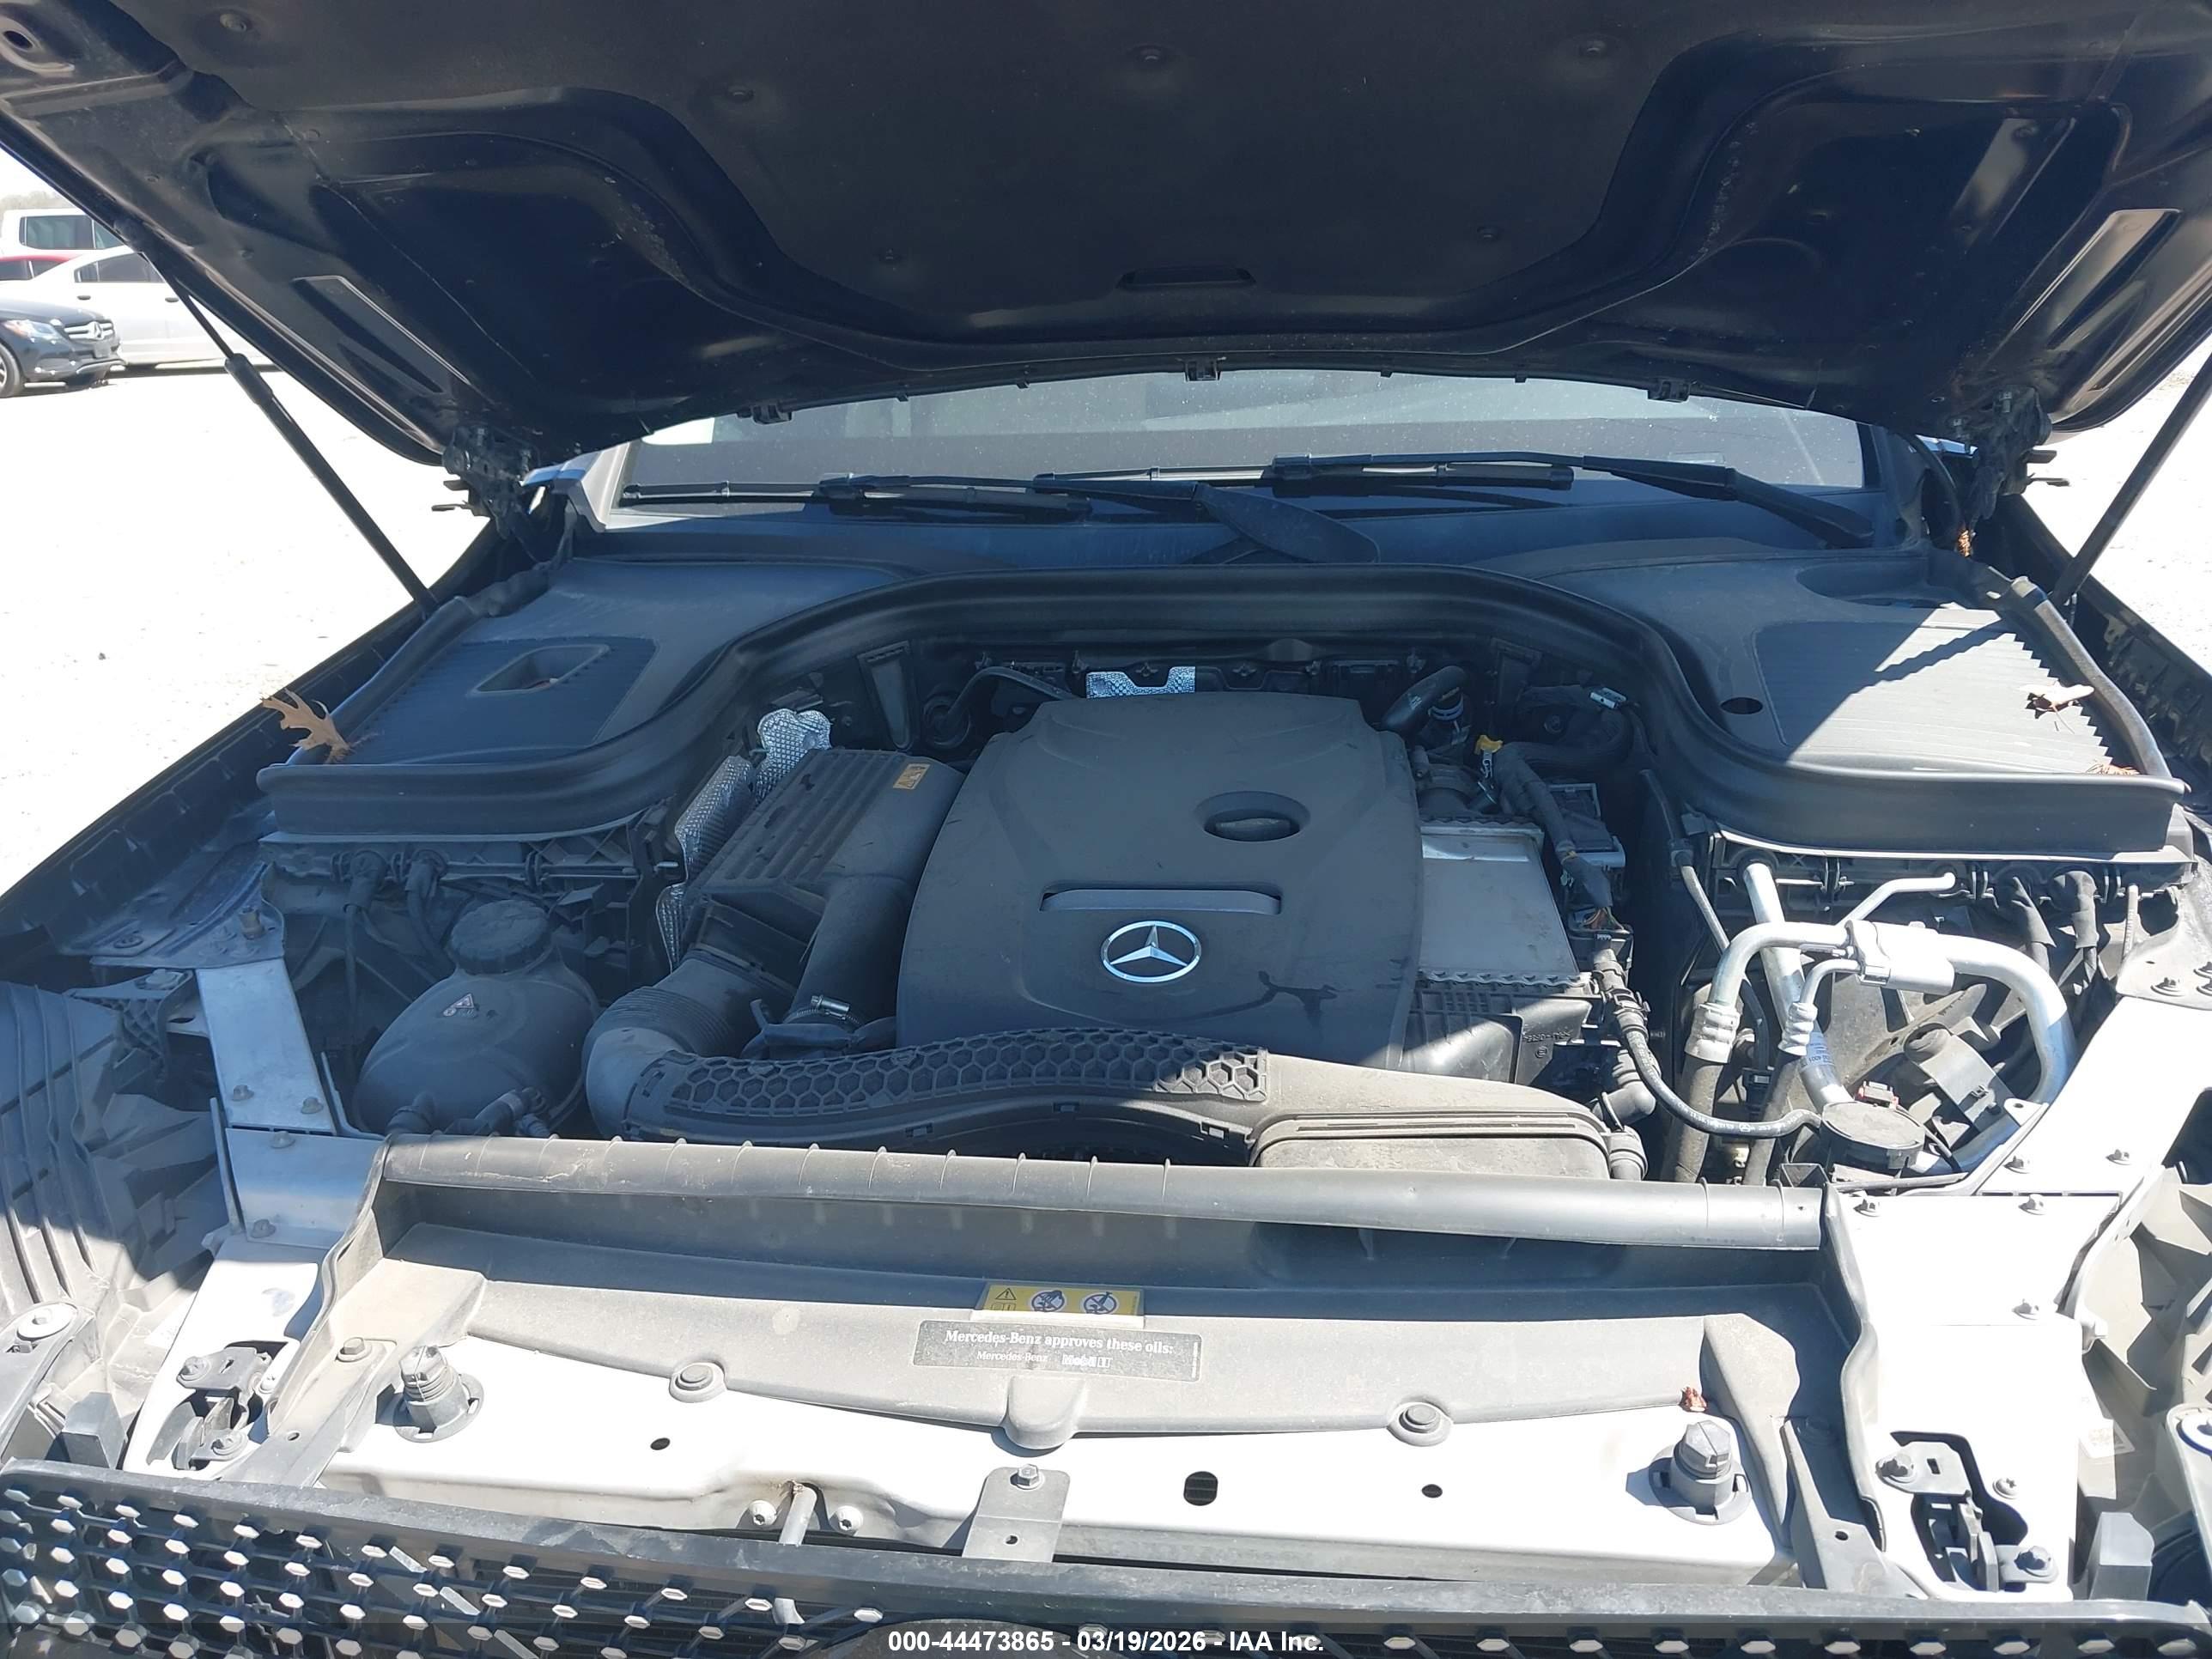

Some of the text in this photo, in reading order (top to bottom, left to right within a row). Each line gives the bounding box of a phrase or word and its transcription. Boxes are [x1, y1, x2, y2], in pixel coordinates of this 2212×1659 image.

[945, 1330, 1042, 1345] Mercedes-Benz
[1044, 1336, 1103, 1349] approves
[1106, 1337, 1142, 1352] these
[976, 1351, 1048, 1362] Mercedes-Benz
